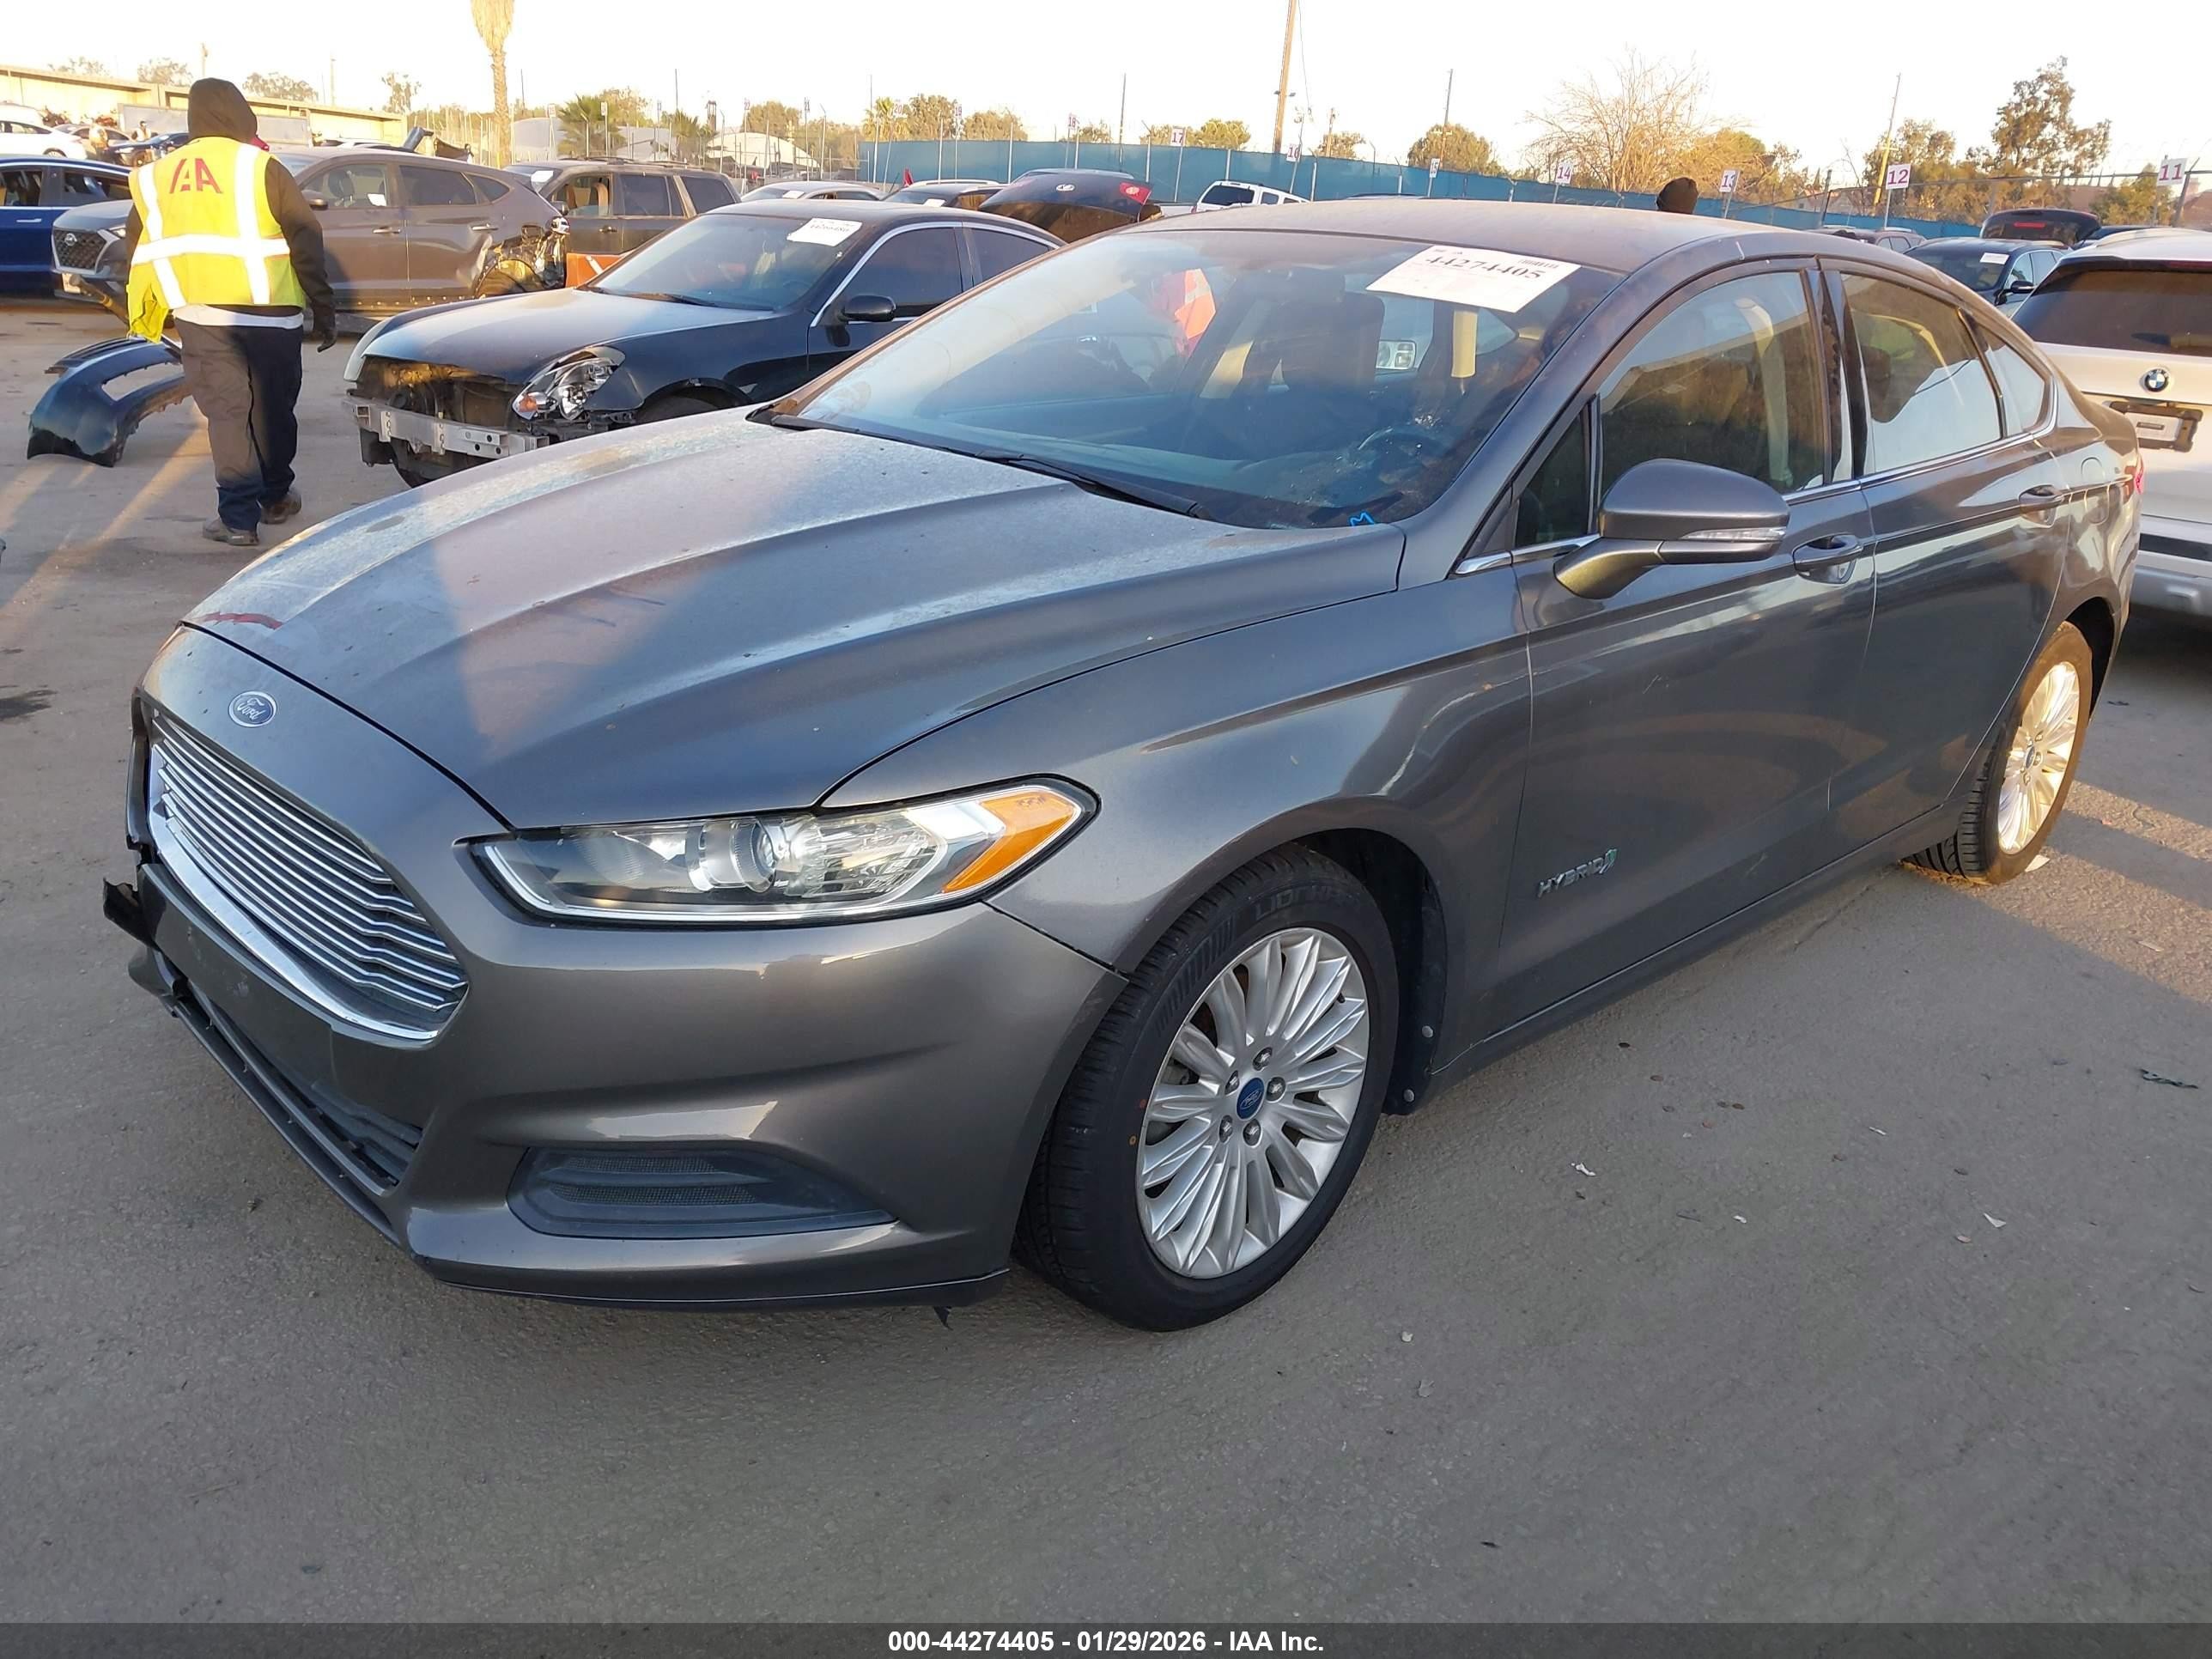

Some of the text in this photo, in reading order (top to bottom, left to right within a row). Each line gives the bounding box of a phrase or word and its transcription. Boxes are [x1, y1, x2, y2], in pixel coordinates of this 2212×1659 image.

[894, 104, 902, 114] 20
[1172, 132, 1183, 143] 17
[1429, 161, 1438, 174] 15
[1557, 167, 1571, 179] 14
[2159, 163, 2183, 180] 11
[1721, 174, 1735, 187] 13
[1887, 169, 1909, 185] 12
[1425, 255, 1547, 280] 44274405
[1538, 857, 1604, 898] HYBRID
